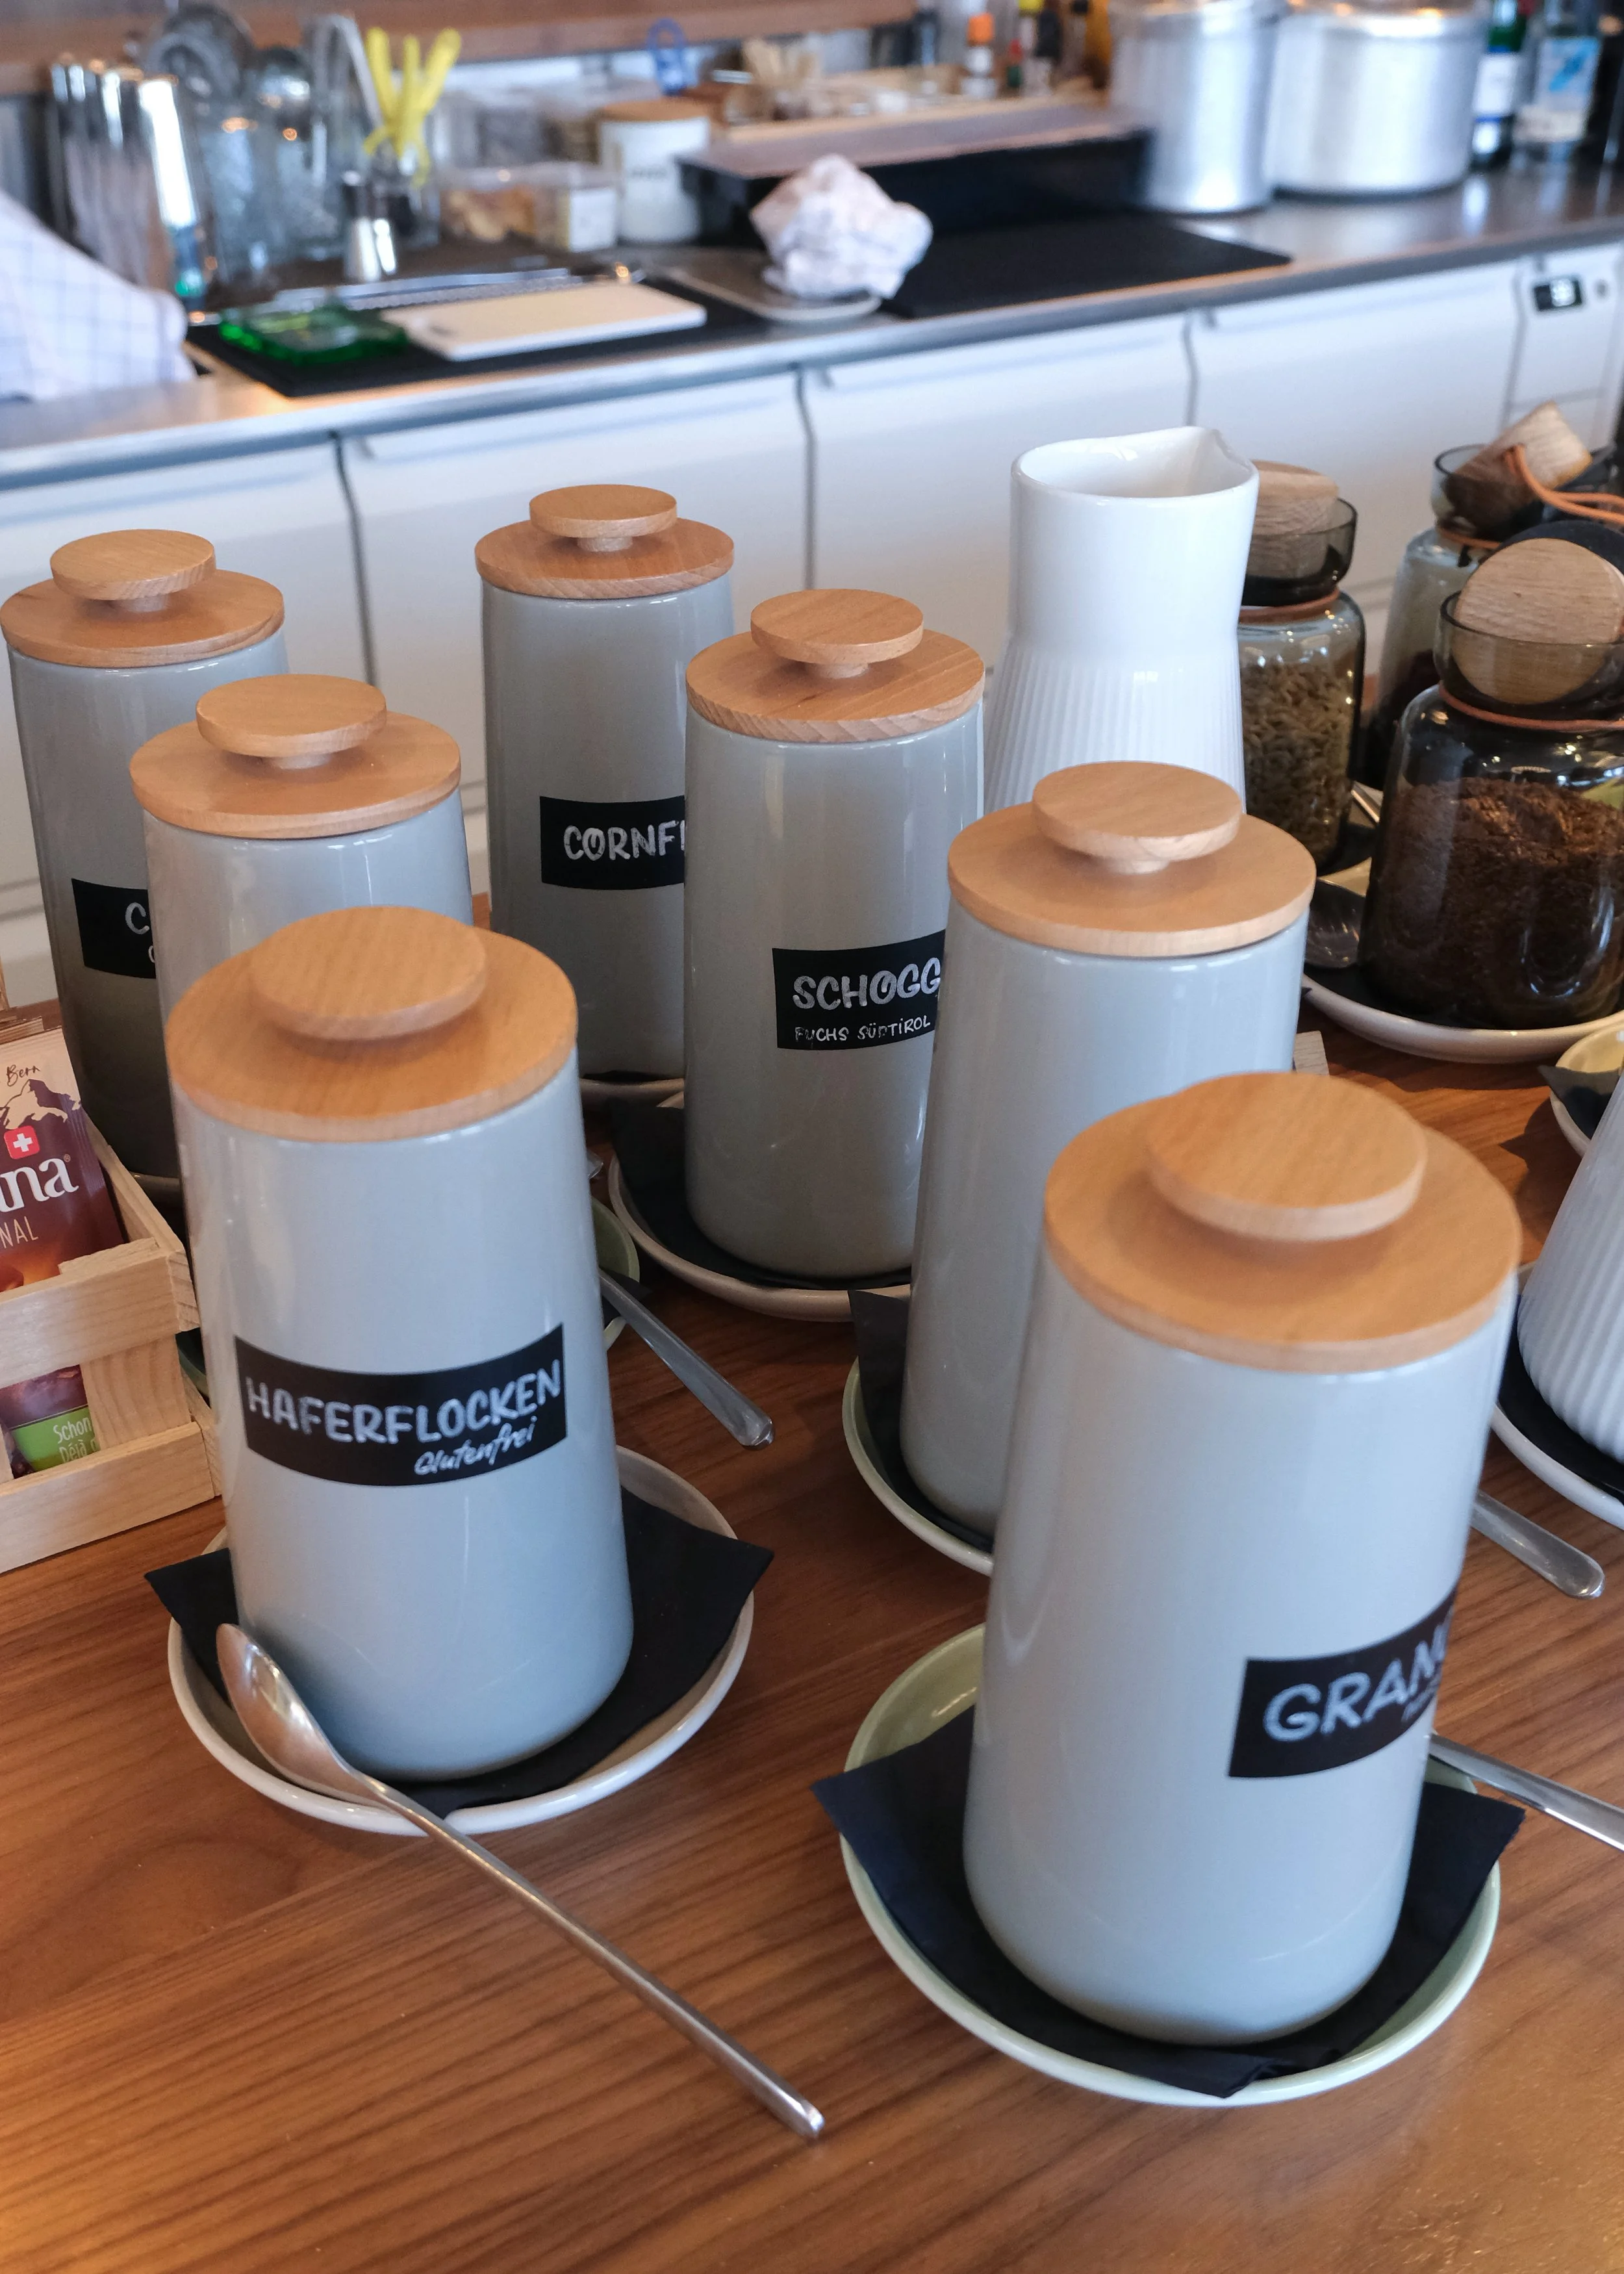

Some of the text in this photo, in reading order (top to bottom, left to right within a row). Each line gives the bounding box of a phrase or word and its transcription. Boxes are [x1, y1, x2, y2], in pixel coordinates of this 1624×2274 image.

[792, 957, 941, 1010] SCHOGG
[6, 1064, 41, 1087] Bern
[0, 1158, 79, 1212] na
[245, 1359, 561, 1444] HAFERFLOCKEN
[53, 1417, 92, 1444] Schon
[1263, 1605, 1454, 1743] GRAN
